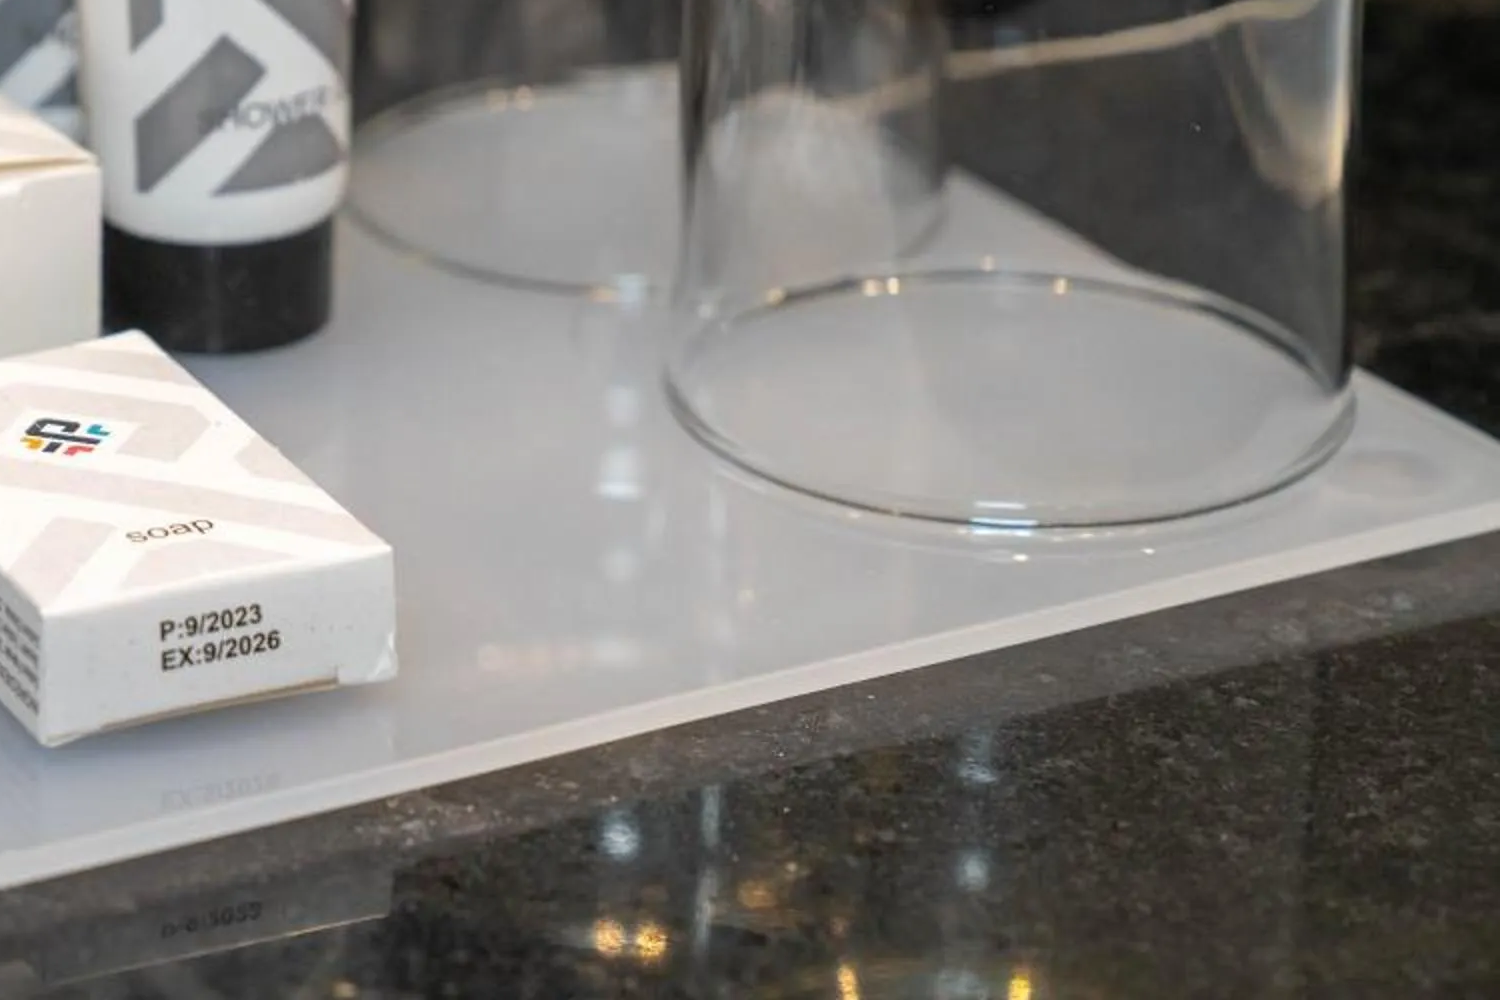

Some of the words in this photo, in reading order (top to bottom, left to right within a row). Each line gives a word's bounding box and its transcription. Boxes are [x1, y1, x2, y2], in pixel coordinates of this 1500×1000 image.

[126, 518, 214, 543] soap
[159, 603, 263, 642] P:9/2023
[161, 629, 281, 673] EX:9/2026
